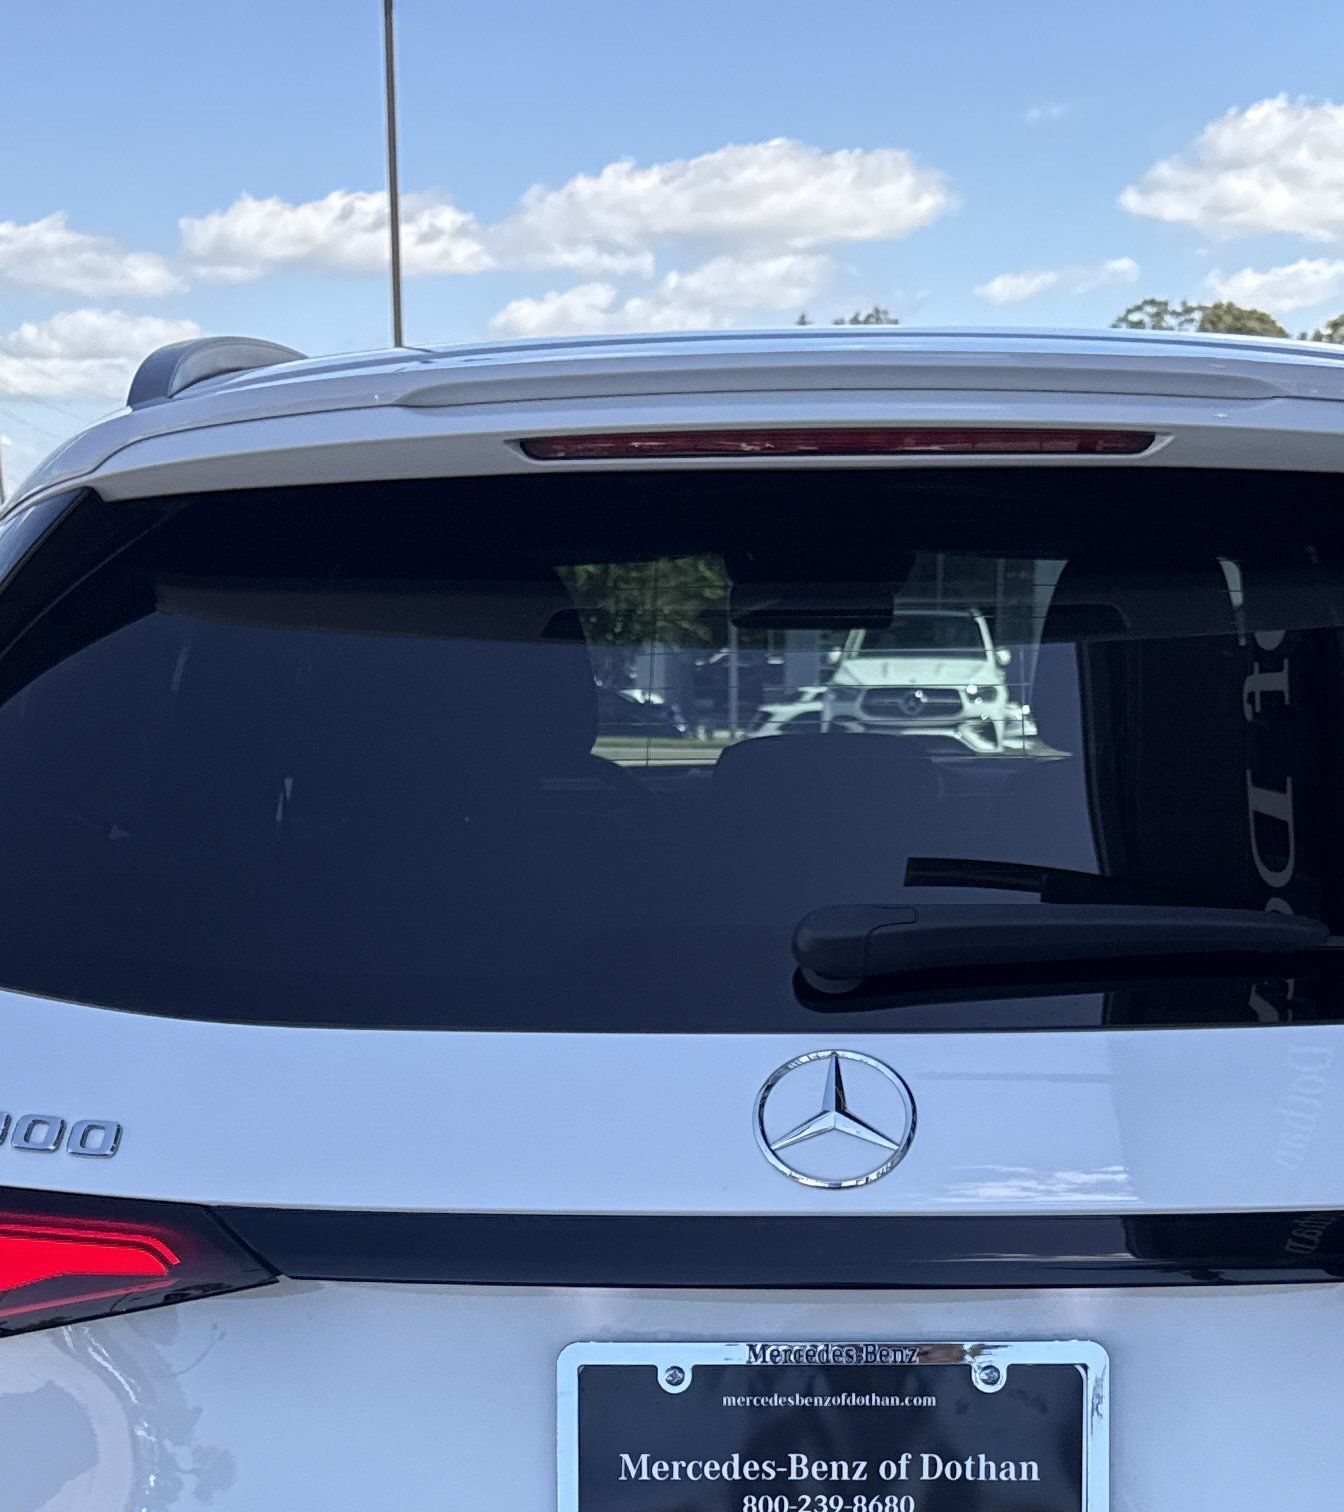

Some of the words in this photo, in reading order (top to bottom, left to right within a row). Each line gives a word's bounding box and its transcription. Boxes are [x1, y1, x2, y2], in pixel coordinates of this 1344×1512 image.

[722, 1393, 937, 1408] mercedesbenzofdothan.com
[618, 1453, 868, 1482] Mercedes-Benz
[879, 1453, 912, 1482] of
[919, 1453, 1041, 1482] Dothan
